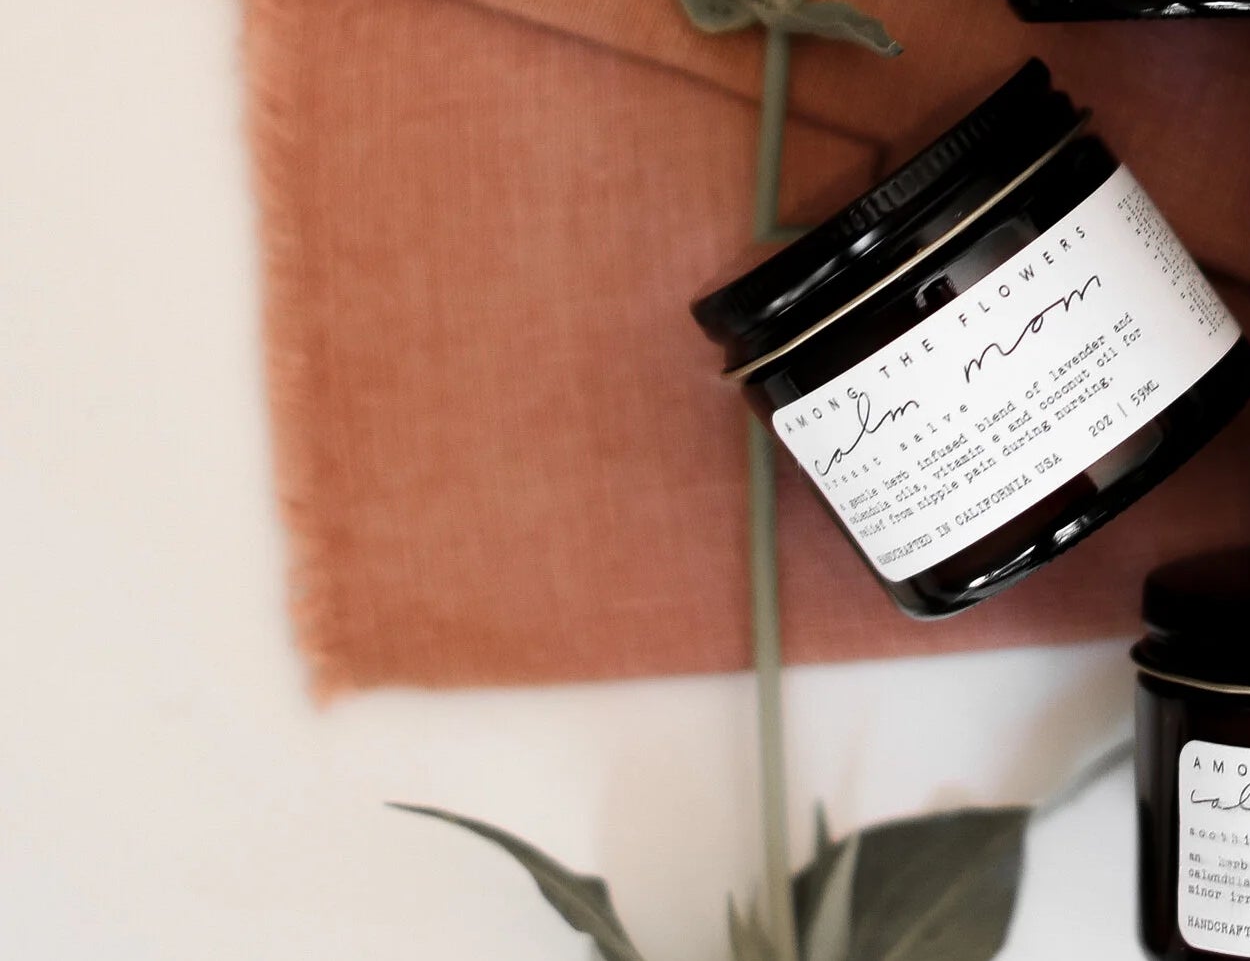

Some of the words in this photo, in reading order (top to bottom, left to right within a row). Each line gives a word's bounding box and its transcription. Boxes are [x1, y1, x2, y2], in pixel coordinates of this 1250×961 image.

[785, 386, 858, 433] AMONG
[878, 338, 934, 378] THE
[958, 225, 1085, 327] FLOWERS
[814, 391, 919, 476] calm
[963, 275, 1101, 383] mom
[882, 469, 910, 490] herb
[917, 432, 968, 471] infused
[974, 400, 1016, 433] blend
[1024, 379, 1041, 400] of
[1048, 335, 1112, 381] lavender
[1113, 311, 1133, 333] and
[932, 444, 985, 479] vitamin
[990, 432, 1001, 444] e
[1007, 409, 1032, 432] and
[1039, 368, 1090, 410] coconut
[1096, 346, 1118, 367] oil
[1122, 327, 1141, 346] for
[899, 404, 968, 451] salve
[916, 480, 959, 510] nipple
[963, 457, 996, 484] pain
[1002, 419, 1051, 456] during
[1053, 376, 1113, 420] nursing.
[935, 521, 951, 538] IN
[954, 474, 1032, 526] CALIFORNIA
[1034, 453, 1062, 474] USA
[1130, 379, 1159, 406] 59ML
[1187, 882, 1222, 899] minor
